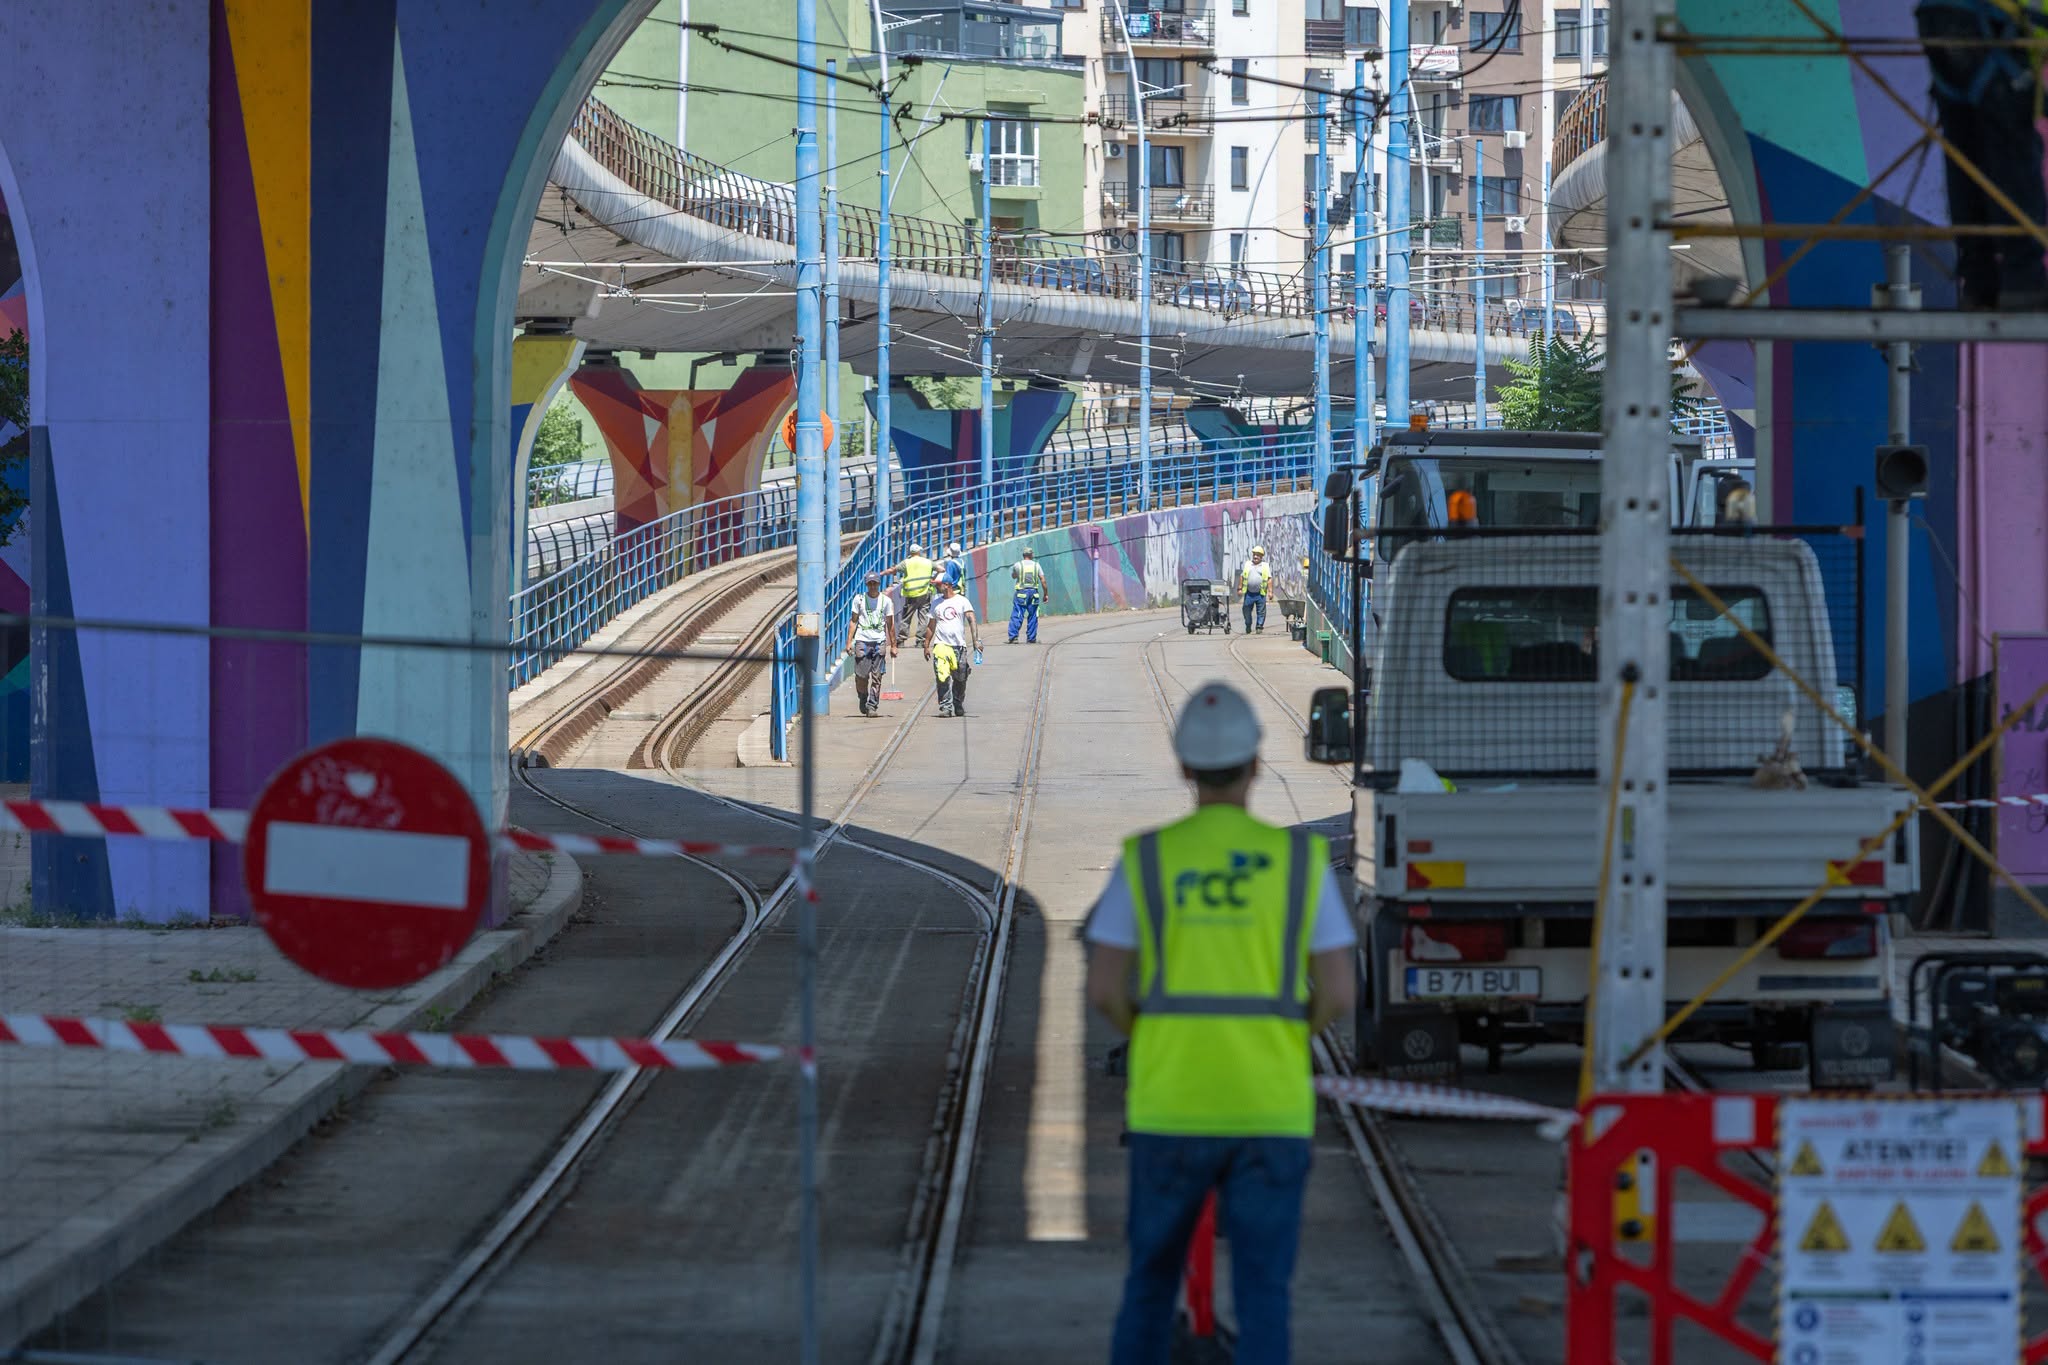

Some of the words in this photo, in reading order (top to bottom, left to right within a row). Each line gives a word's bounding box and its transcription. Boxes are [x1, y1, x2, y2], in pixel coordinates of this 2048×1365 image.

[1428, 971, 1443, 993] B
[1452, 971, 1473, 993] 71
[1482, 971, 1520, 993] BUI
